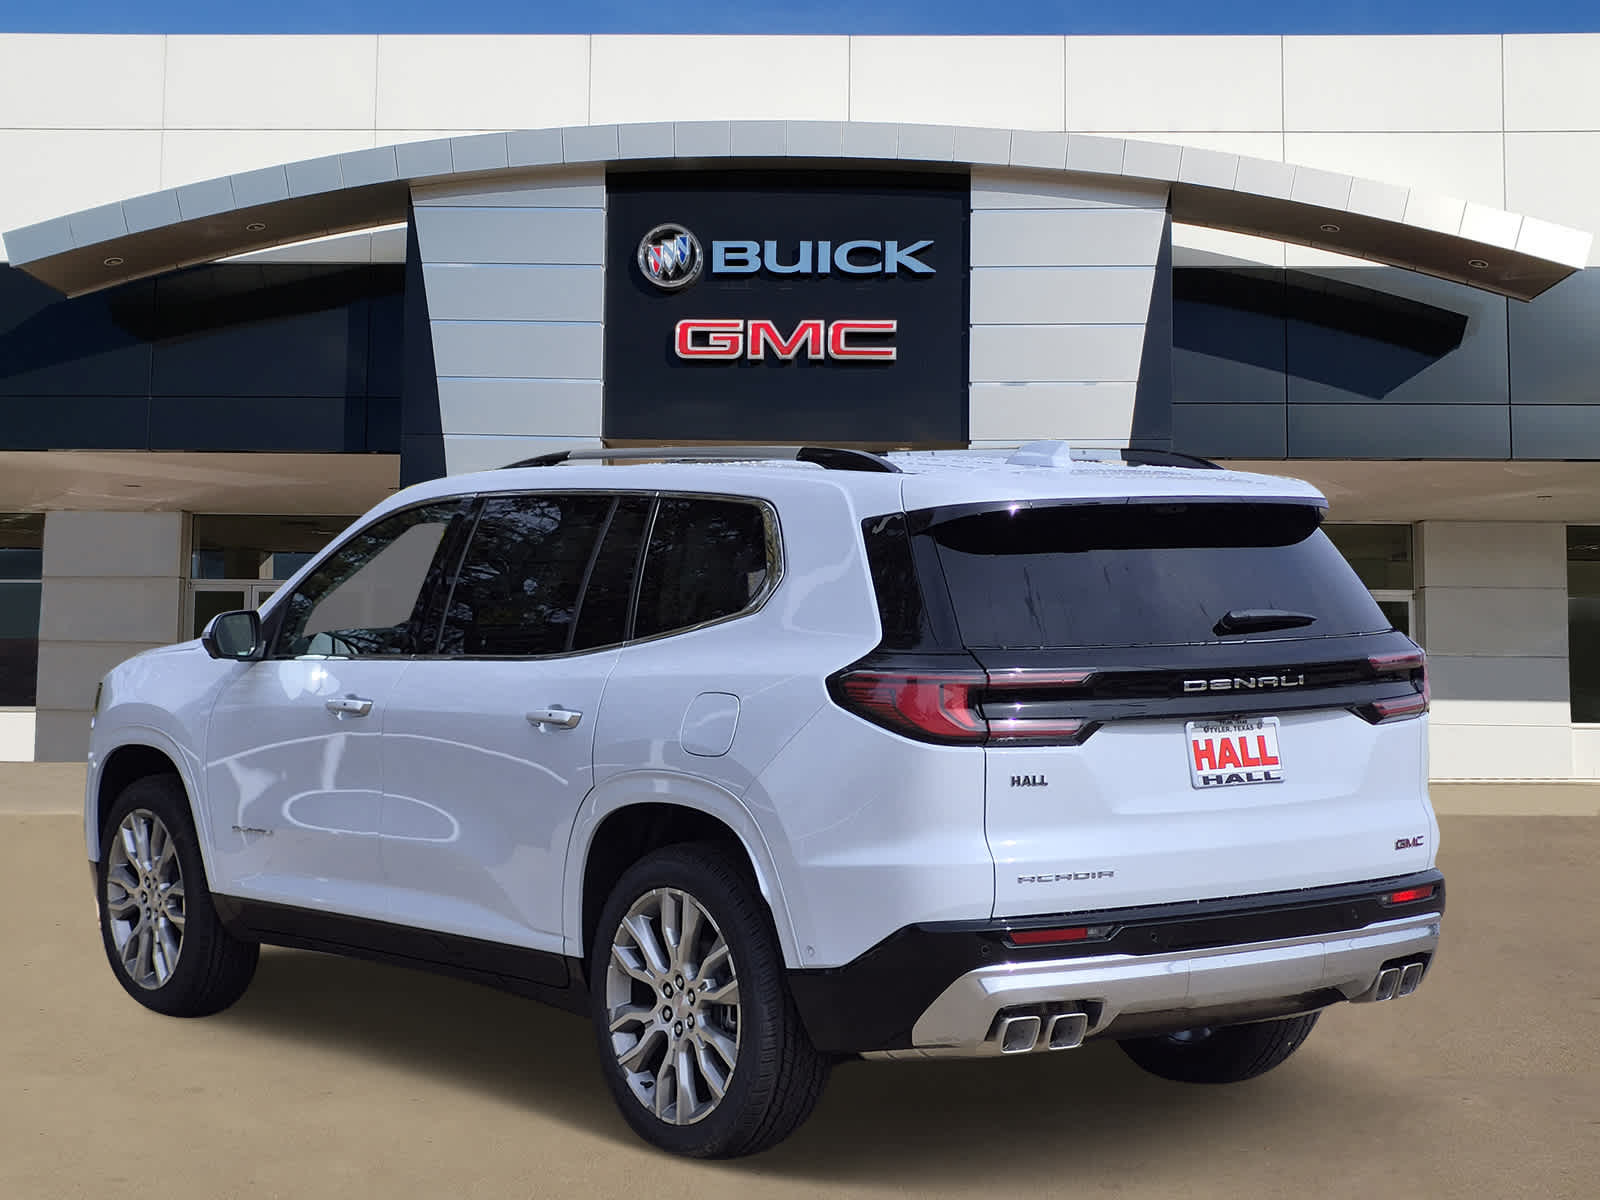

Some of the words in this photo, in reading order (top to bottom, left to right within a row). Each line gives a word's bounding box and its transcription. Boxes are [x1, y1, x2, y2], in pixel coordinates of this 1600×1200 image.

[712, 240, 936, 273] BUICK
[674, 319, 897, 360] GMC
[1184, 674, 1304, 692] DENALI
[1192, 735, 1279, 771] HALL
[1010, 775, 1048, 787] HALL
[1202, 771, 1280, 785] HALL
[1394, 835, 1424, 851] GMC
[1017, 871, 1114, 884] ACADIA
